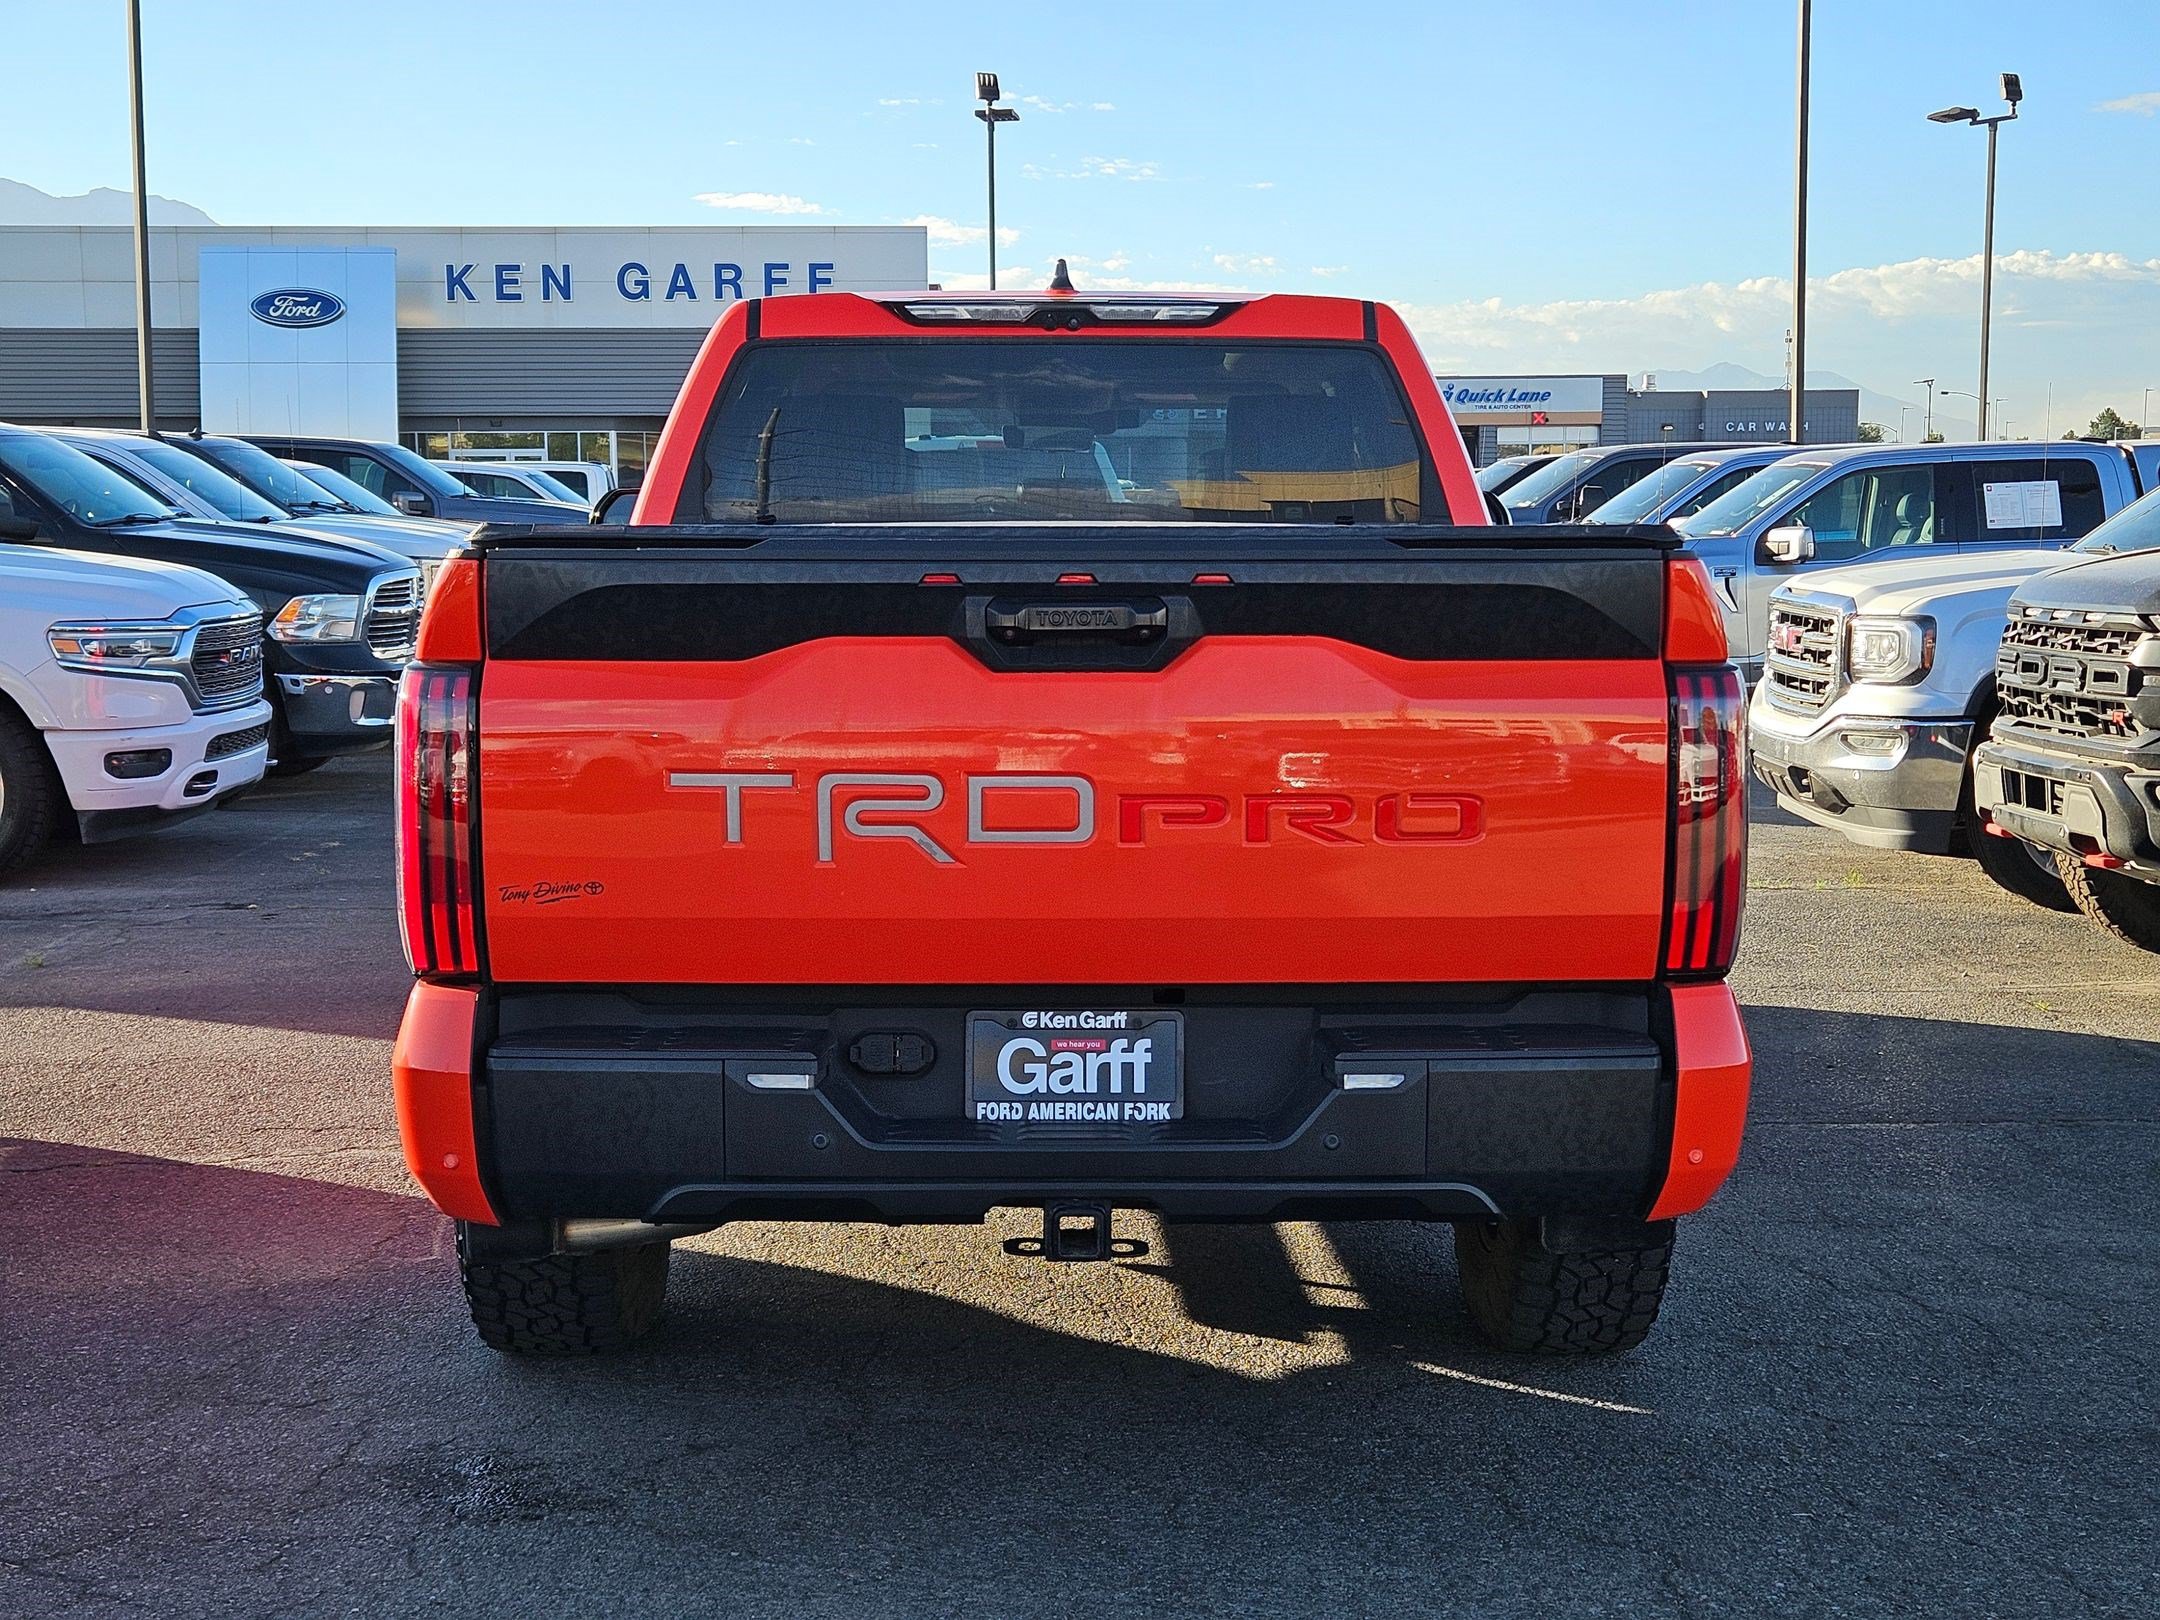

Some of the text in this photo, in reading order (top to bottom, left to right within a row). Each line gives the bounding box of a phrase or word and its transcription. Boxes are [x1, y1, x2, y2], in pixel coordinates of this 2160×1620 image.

[445, 261, 835, 301] KEN GARFF
[269, 295, 321, 317] Ford
[1455, 388, 1551, 405] Quick Lane
[1725, 422, 1757, 432] CAR
[1036, 610, 1118, 627] TOYOTA
[666, 770, 1486, 866] TRD PRO
[499, 881, 582, 904] Tony Divino
[1039, 1011, 1128, 1029] Ken Garff
[1069, 1040, 1083, 1048] hear
[1084, 1041, 1101, 1050] you
[997, 1037, 1152, 1095] Garff
[976, 1102, 1171, 1121] FORD AMERICAN FORK
